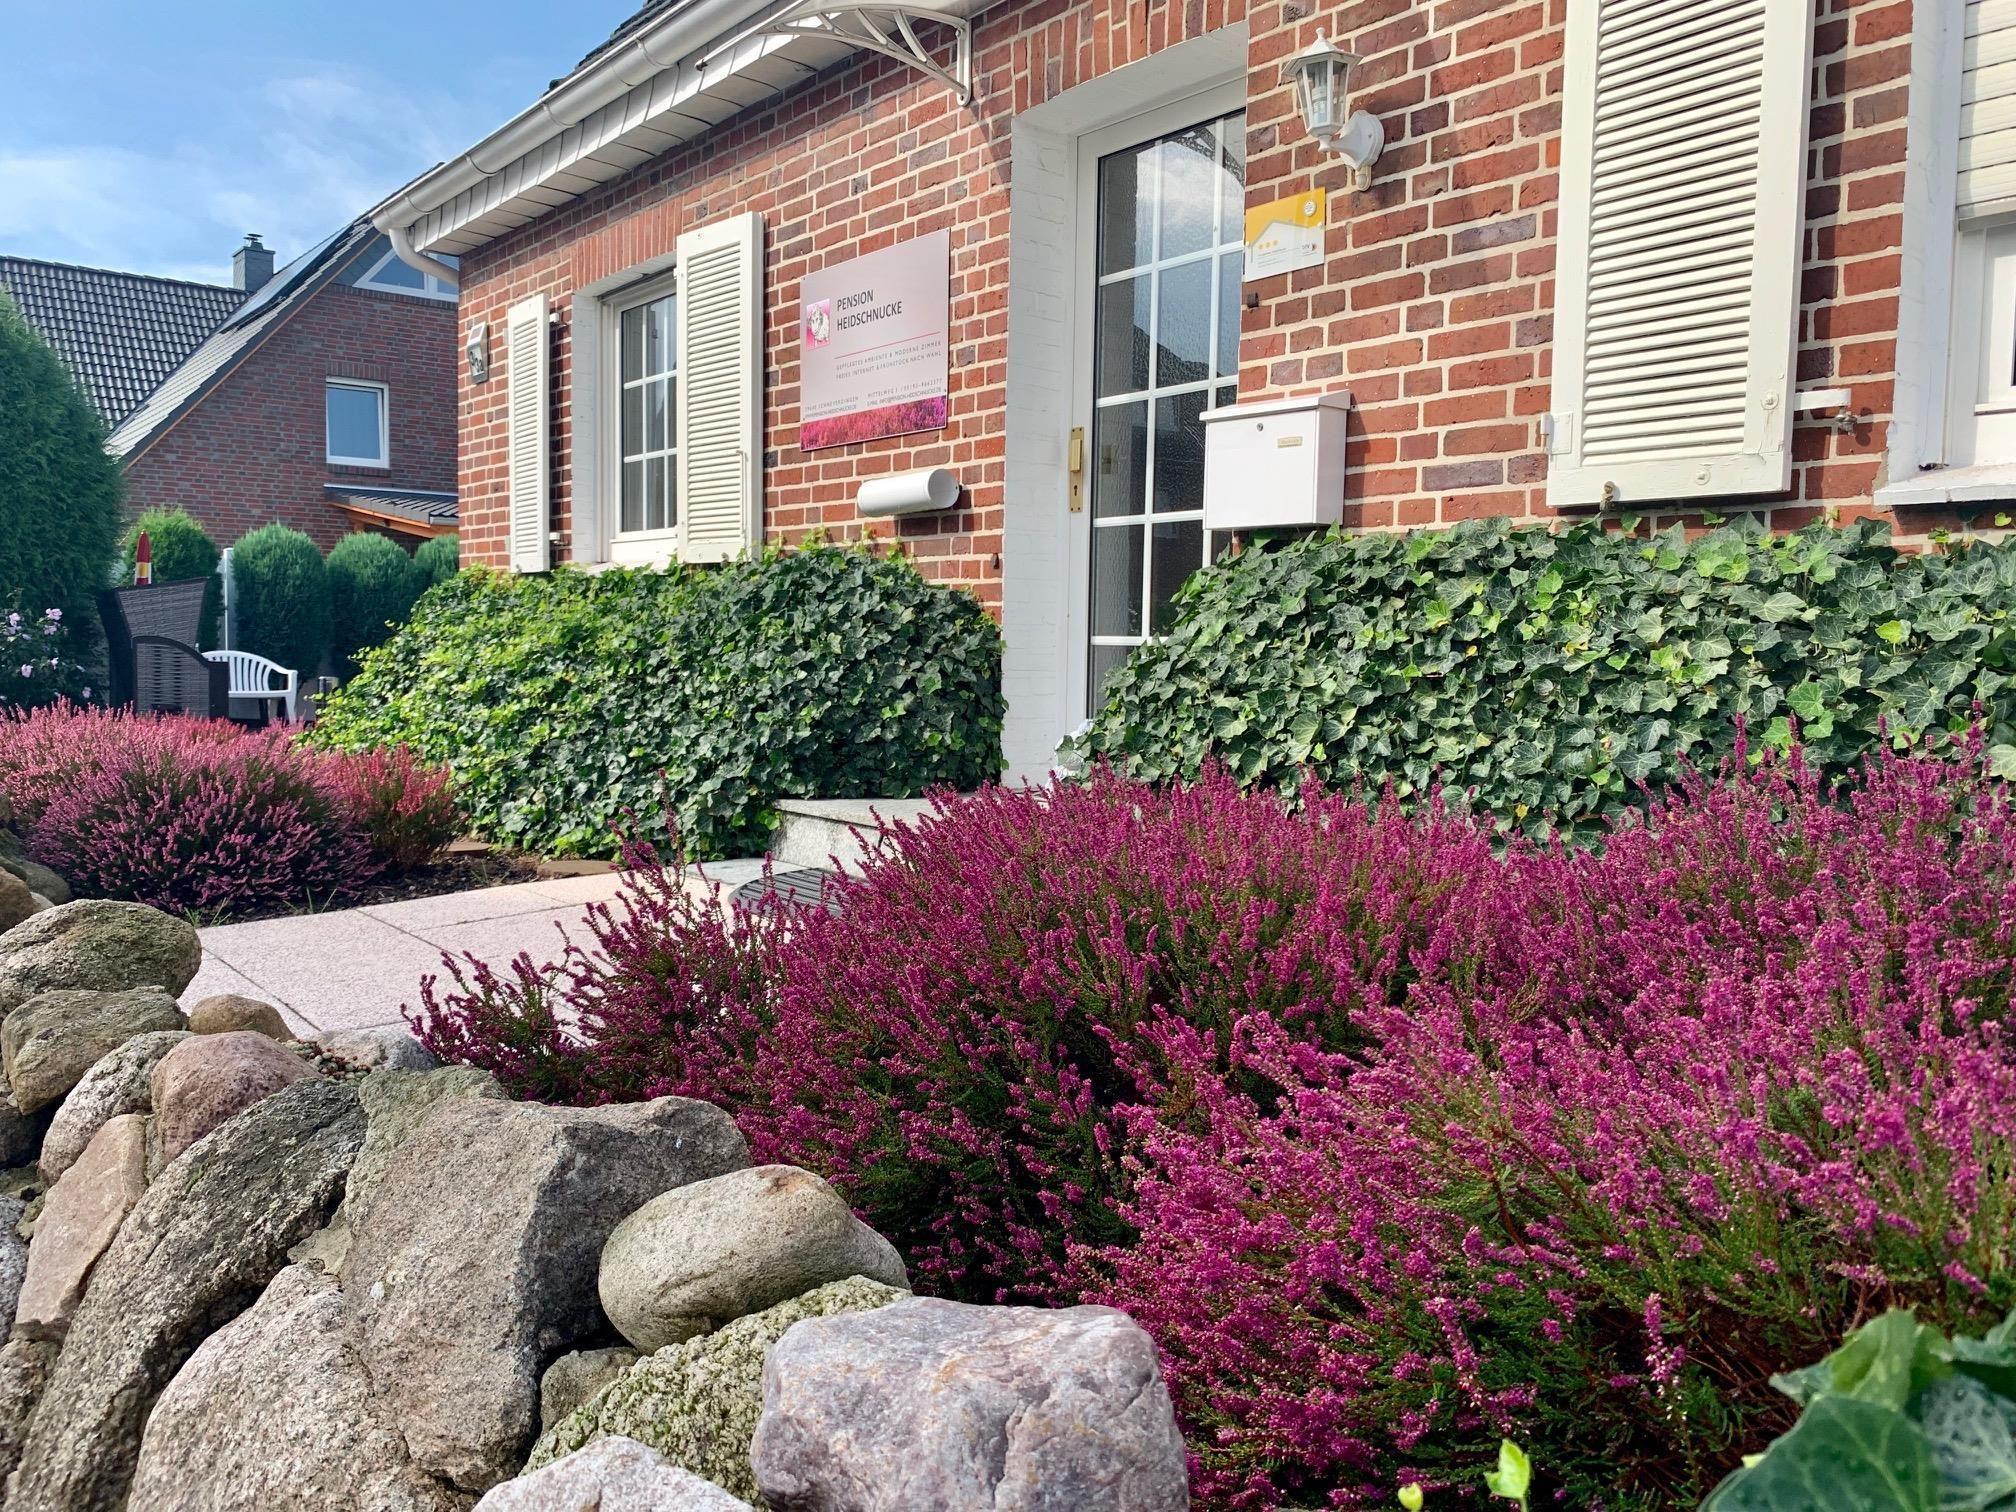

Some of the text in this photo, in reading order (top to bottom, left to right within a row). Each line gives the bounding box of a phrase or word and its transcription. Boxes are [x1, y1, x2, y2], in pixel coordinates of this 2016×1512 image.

[837, 289, 874, 312] PENSION
[837, 301, 903, 331] HEIDSCHNUCKE
[921, 340, 942, 350] ZIMMER
